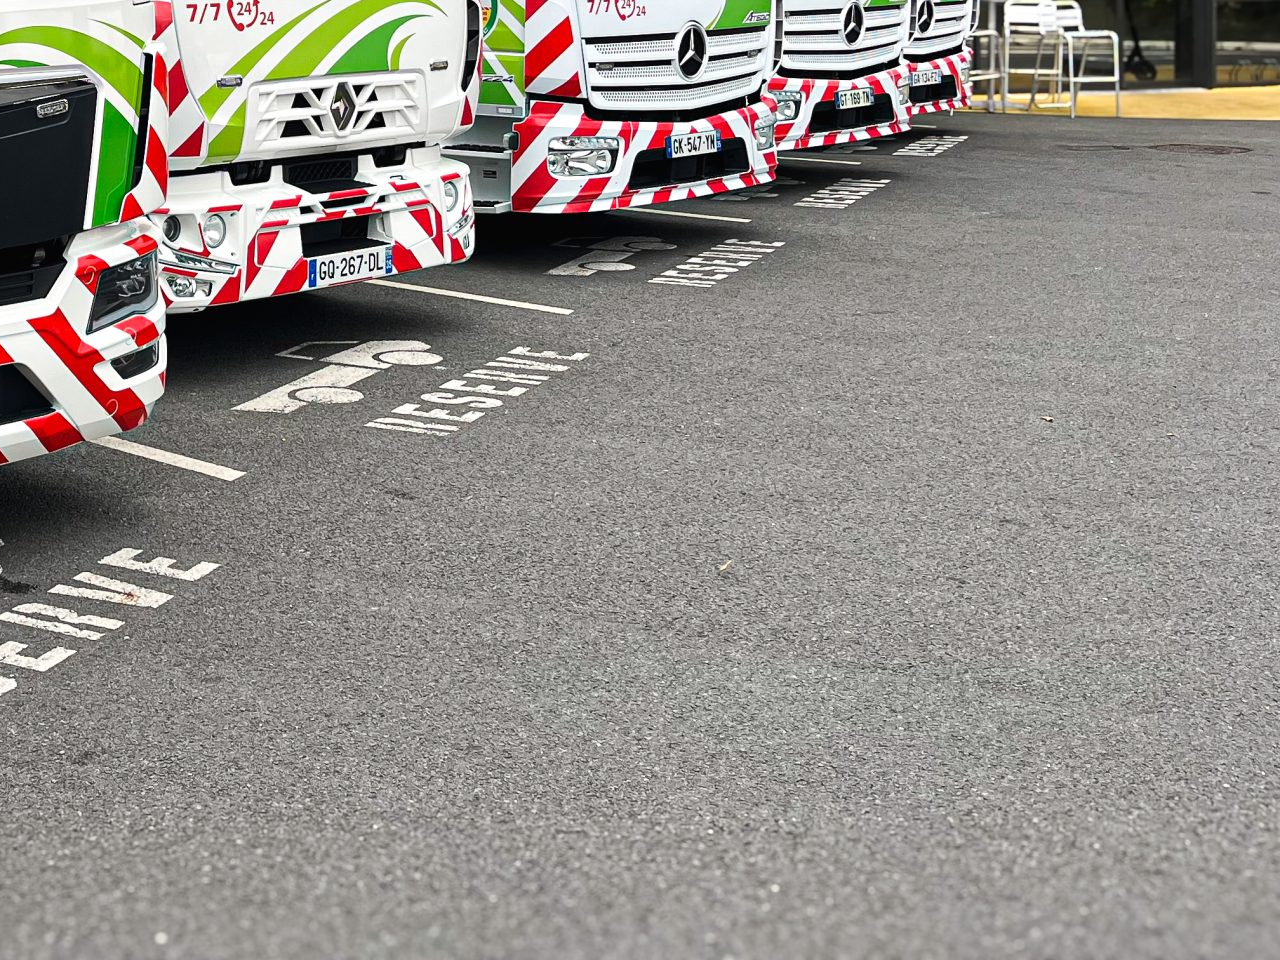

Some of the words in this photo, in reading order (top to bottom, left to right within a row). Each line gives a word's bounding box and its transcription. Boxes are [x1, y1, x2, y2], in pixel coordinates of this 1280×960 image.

[185, 2, 221, 25] 7/7
[236, 1, 253, 16] 24
[260, 11, 275, 25] 24
[586, 0, 611, 15] 7/7
[636, 5, 647, 17] 24
[840, 90, 870, 107] GT-169-TN
[672, 134, 716, 155] GK-547-YN
[319, 251, 384, 281] GQ-267-DL
